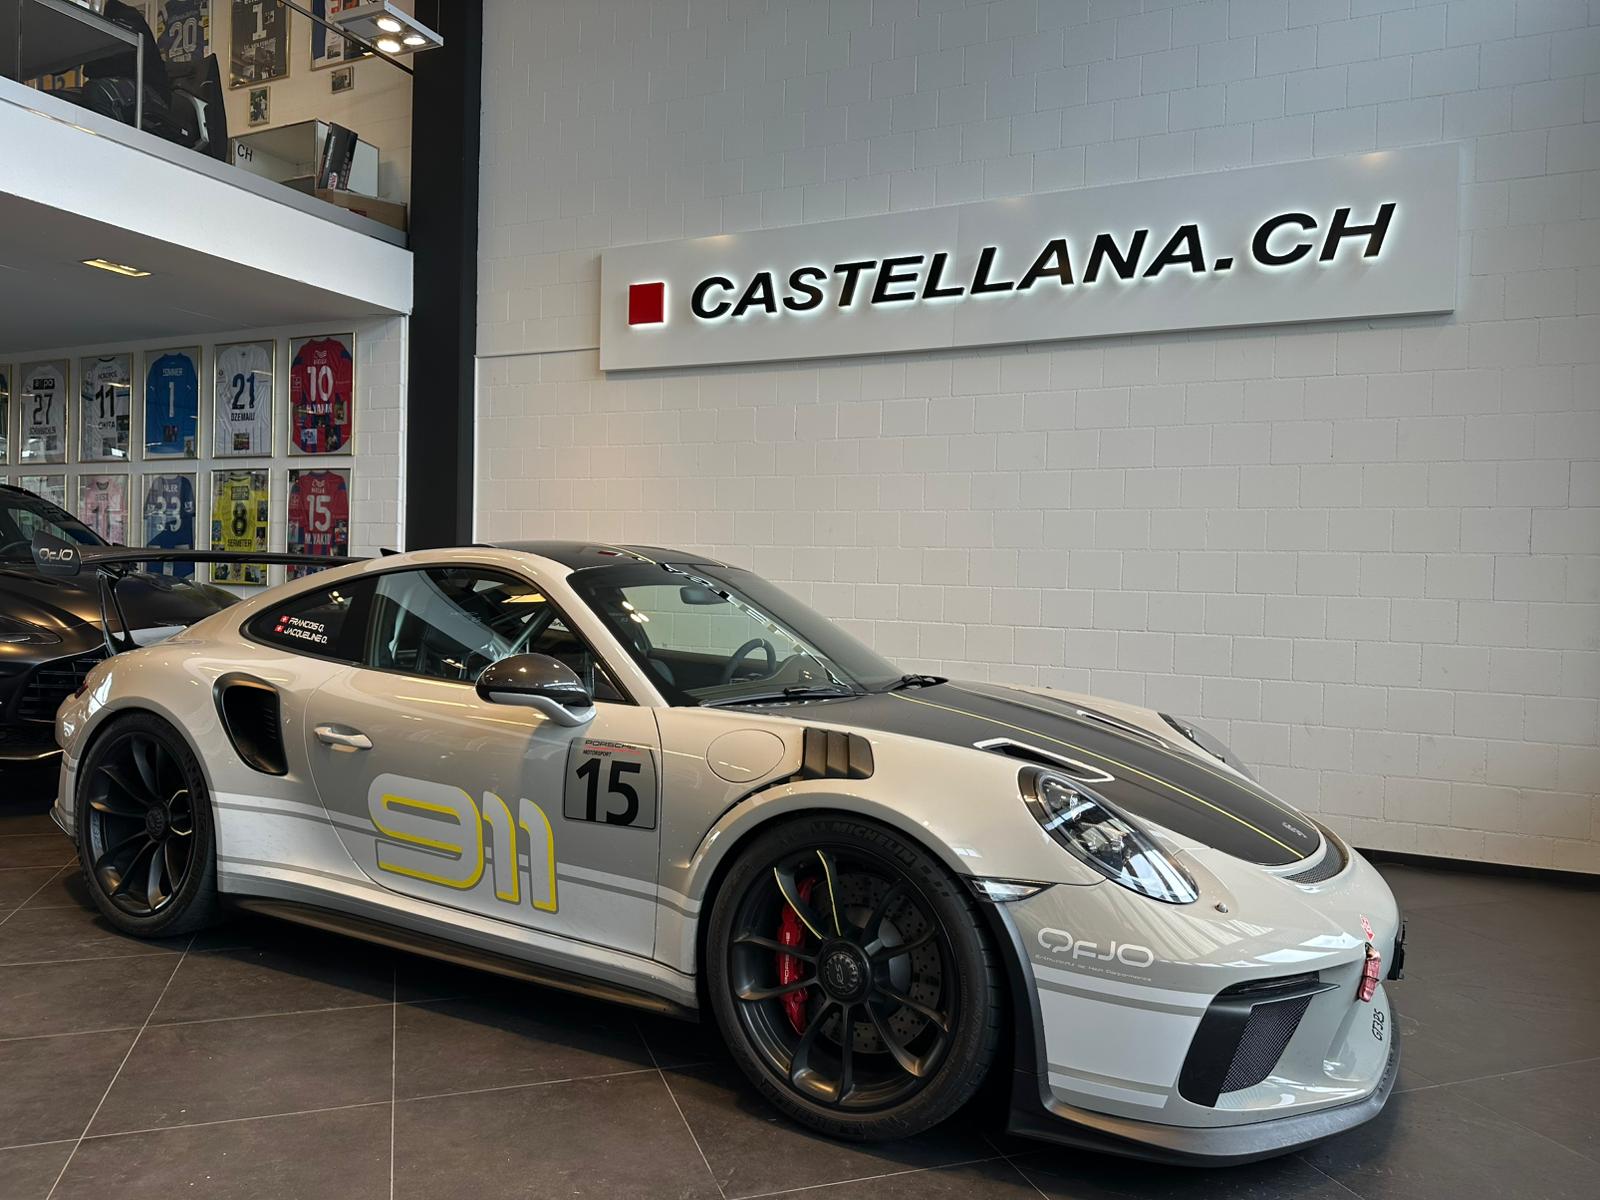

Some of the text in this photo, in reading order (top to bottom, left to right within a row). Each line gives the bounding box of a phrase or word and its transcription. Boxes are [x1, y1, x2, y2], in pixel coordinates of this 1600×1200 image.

[168, 17, 198, 58] 20
[237, 144, 253, 162] CH
[690, 202, 1397, 319] CASTELLANA.CH
[95, 384, 115, 419] 11
[168, 381, 175, 418] 1
[231, 371, 256, 410] 21
[307, 365, 334, 402] 10
[33, 393, 54, 425] 27
[231, 500, 248, 537] 8
[306, 494, 332, 532] 15
[284, 628, 321, 642] JACQUELINE
[289, 617, 318, 630] FRANCOIS
[576, 758, 641, 826] 15
[367, 772, 559, 914] 911
